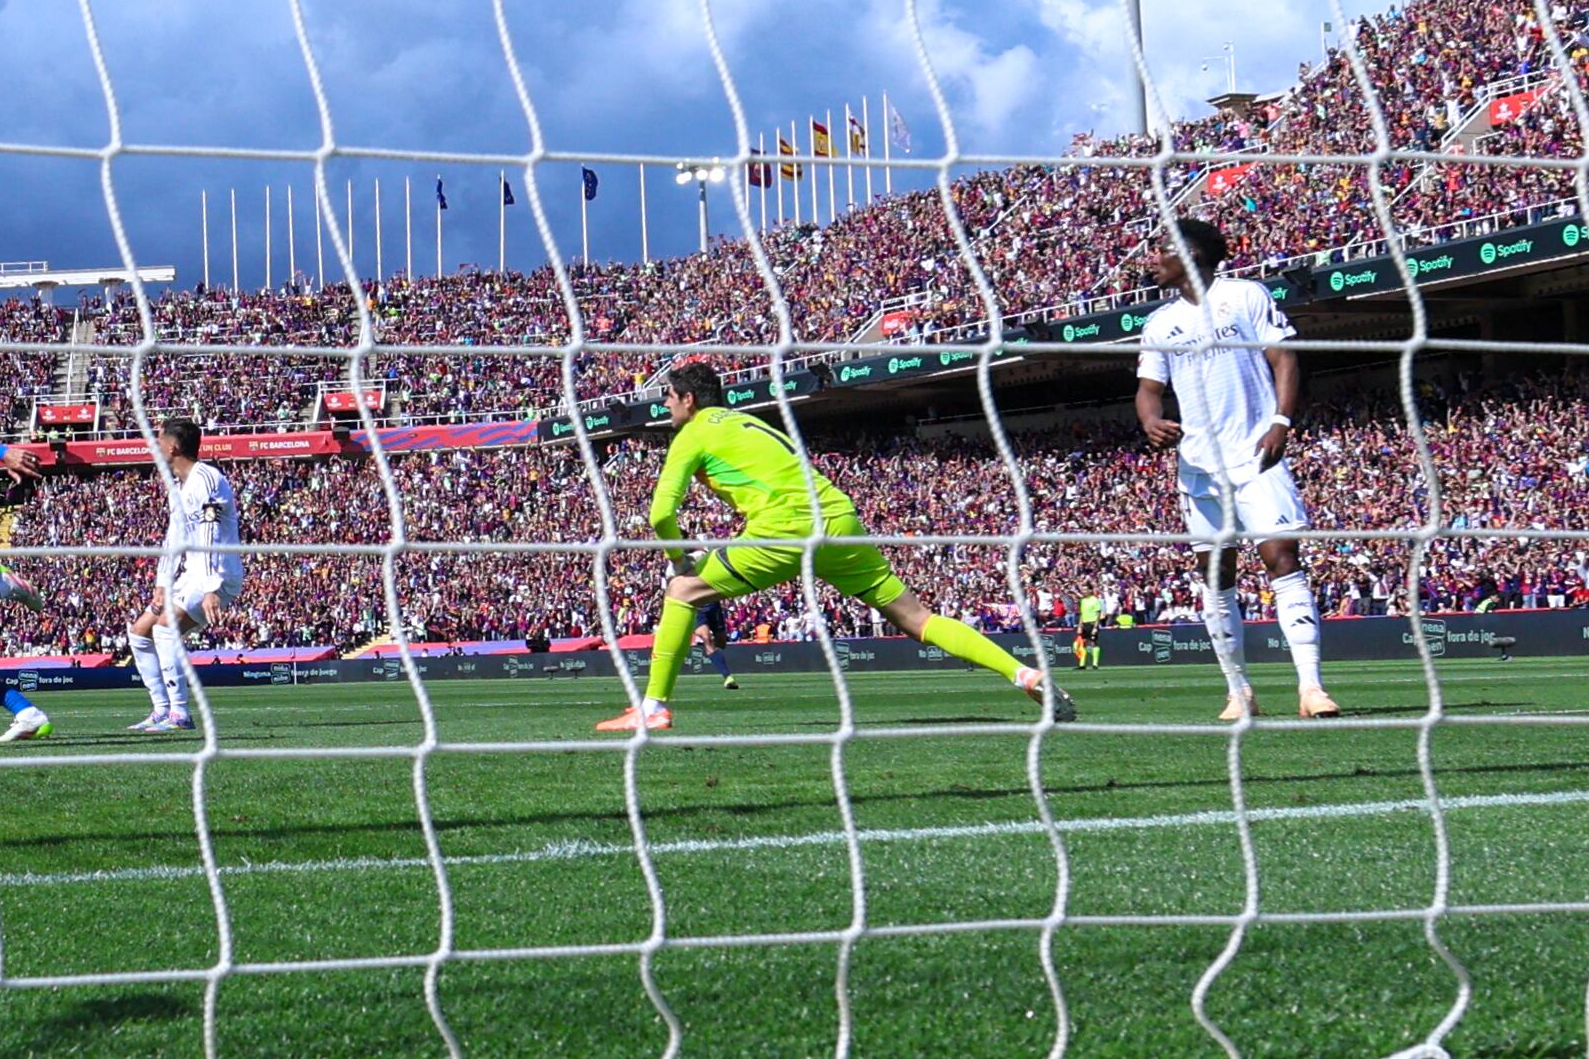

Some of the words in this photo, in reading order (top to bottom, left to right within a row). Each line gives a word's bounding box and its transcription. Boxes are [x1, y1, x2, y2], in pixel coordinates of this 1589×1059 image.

[1497, 239, 1533, 257] Spotify
[1419, 255, 1454, 272] Spotify
[1344, 270, 1378, 286] Spotify
[1075, 323, 1100, 338] Spotify
[899, 357, 922, 369] Spotify
[850, 366, 871, 378] Spotify
[269, 441, 310, 449] BARCELONA
[1447, 630, 1464, 642] fora
[1468, 629, 1479, 642] de
[1138, 642, 1153, 653] Cap
[1268, 638, 1279, 649] No
[5, 677, 19, 685] Cap
[62, 675, 74, 685] joc
